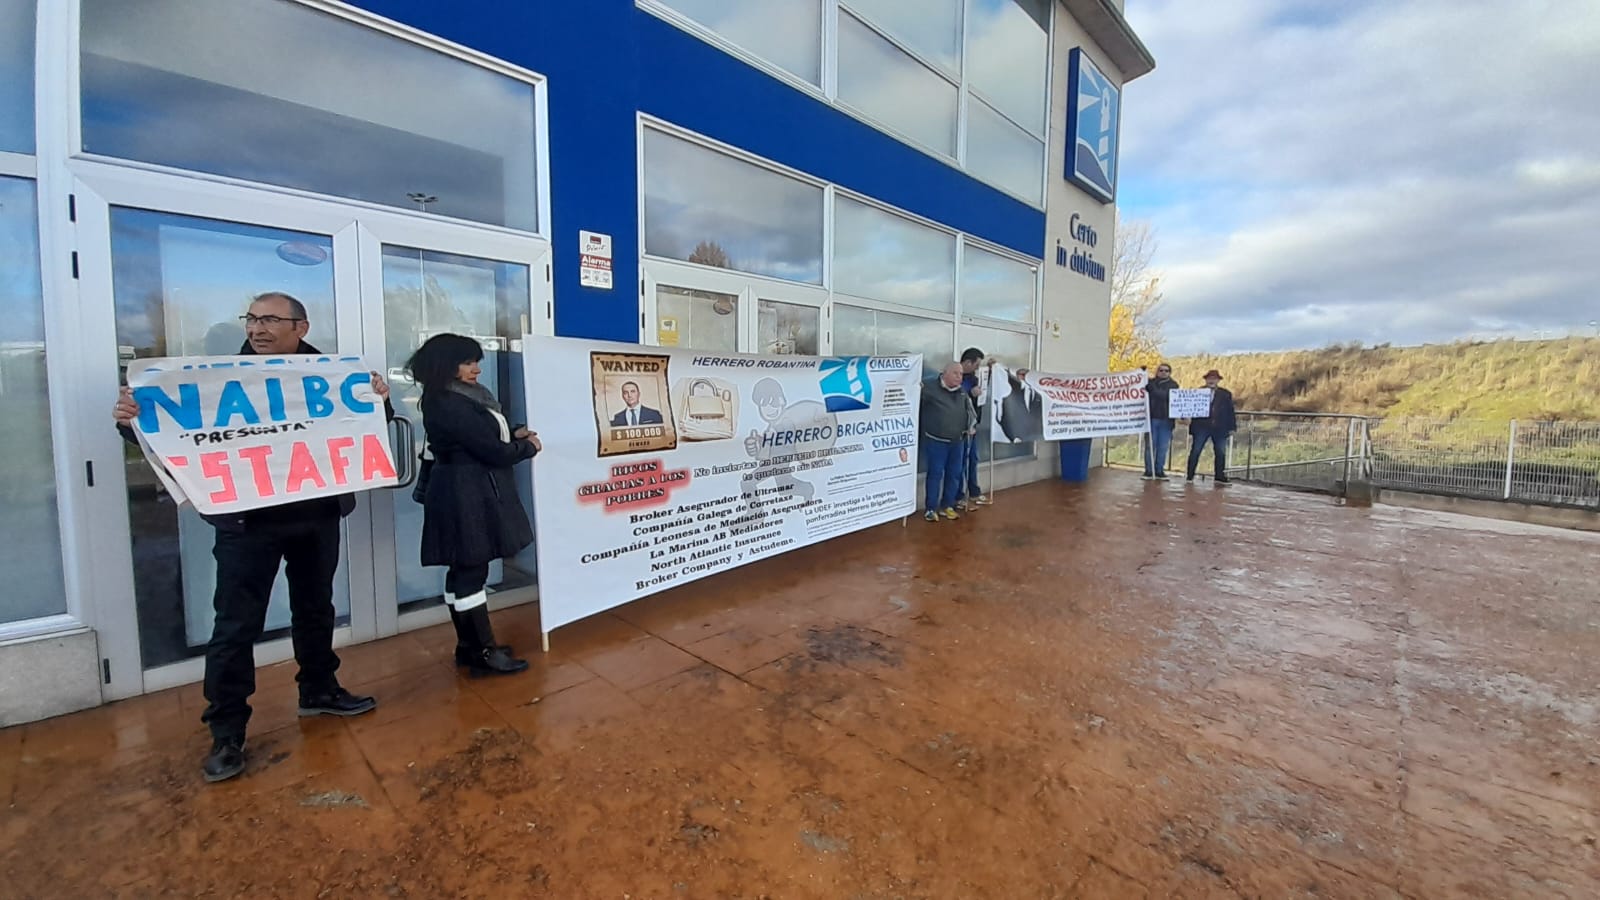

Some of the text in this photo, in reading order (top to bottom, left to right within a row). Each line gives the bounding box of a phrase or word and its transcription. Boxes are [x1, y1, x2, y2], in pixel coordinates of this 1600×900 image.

[1070, 213, 1097, 248] Certo
[582, 255, 611, 267] Alarma
[1056, 238, 1105, 282] in dubium
[600, 360, 660, 373] WANTED
[692, 357, 816, 369] HERRERO ROBANTINA
[1039, 373, 1143, 391] GRANDES SUELDOS
[133, 372, 376, 434] NAIBC
[616, 428, 661, 440] $ 100,000
[761, 417, 914, 448] HERRERO BRIGANTINA
[166, 434, 399, 504] STAFA
[612, 462, 658, 477] RICOS
[694, 468, 710, 478] No
[712, 461, 758, 475] inviertas
[759, 459, 771, 467] en
[772, 450, 817, 465] HERRERO
[578, 471, 686, 496] GRACIAS A LOS
[606, 488, 665, 506] POBRES
[629, 483, 795, 524] Broker Asegurador de Ultramar
[633, 494, 794, 536] Compañía Galega de Corretaxe
[806, 509, 846, 526] ponferradina
[871, 496, 898, 508] Brigantina
[814, 502, 832, 514] UDEF
[833, 496, 860, 510] investiga
[872, 490, 896, 500] empresa
[580, 499, 823, 564] Compañía Leonesa de Mediación Aseguradora
[649, 518, 784, 559] La Marina AB Mediadores
[650, 529, 782, 572] North Atlantic Insurance
[635, 572, 679, 591] Broker
[682, 555, 732, 576] Company
[737, 552, 744, 561] y
